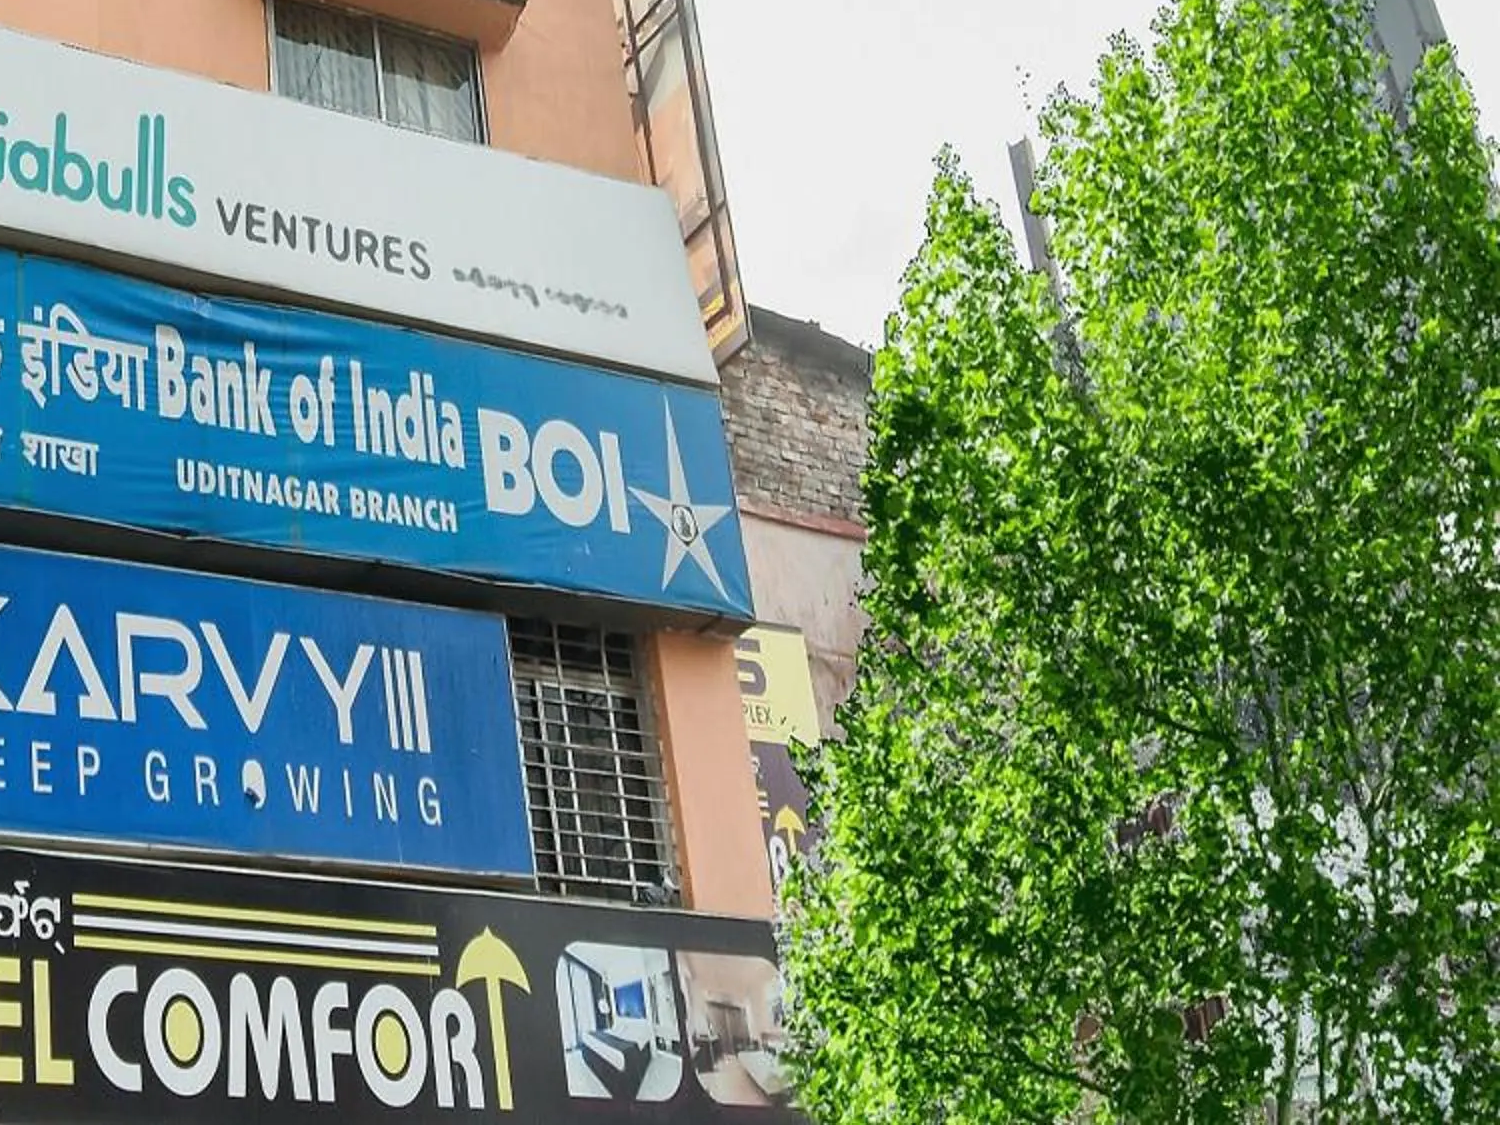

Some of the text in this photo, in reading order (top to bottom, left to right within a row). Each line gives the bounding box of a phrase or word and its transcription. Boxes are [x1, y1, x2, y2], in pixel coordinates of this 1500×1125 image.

[216, 197, 432, 281] VENTURES
[17, 303, 149, 411] इंडिया
[155, 324, 468, 469] Bank of India
[20, 431, 99, 476] शाखा
[177, 457, 458, 534] UDITNAGAR BRANCH
[477, 407, 631, 534] BOI
[87, 925, 532, 1111] COMFORT
